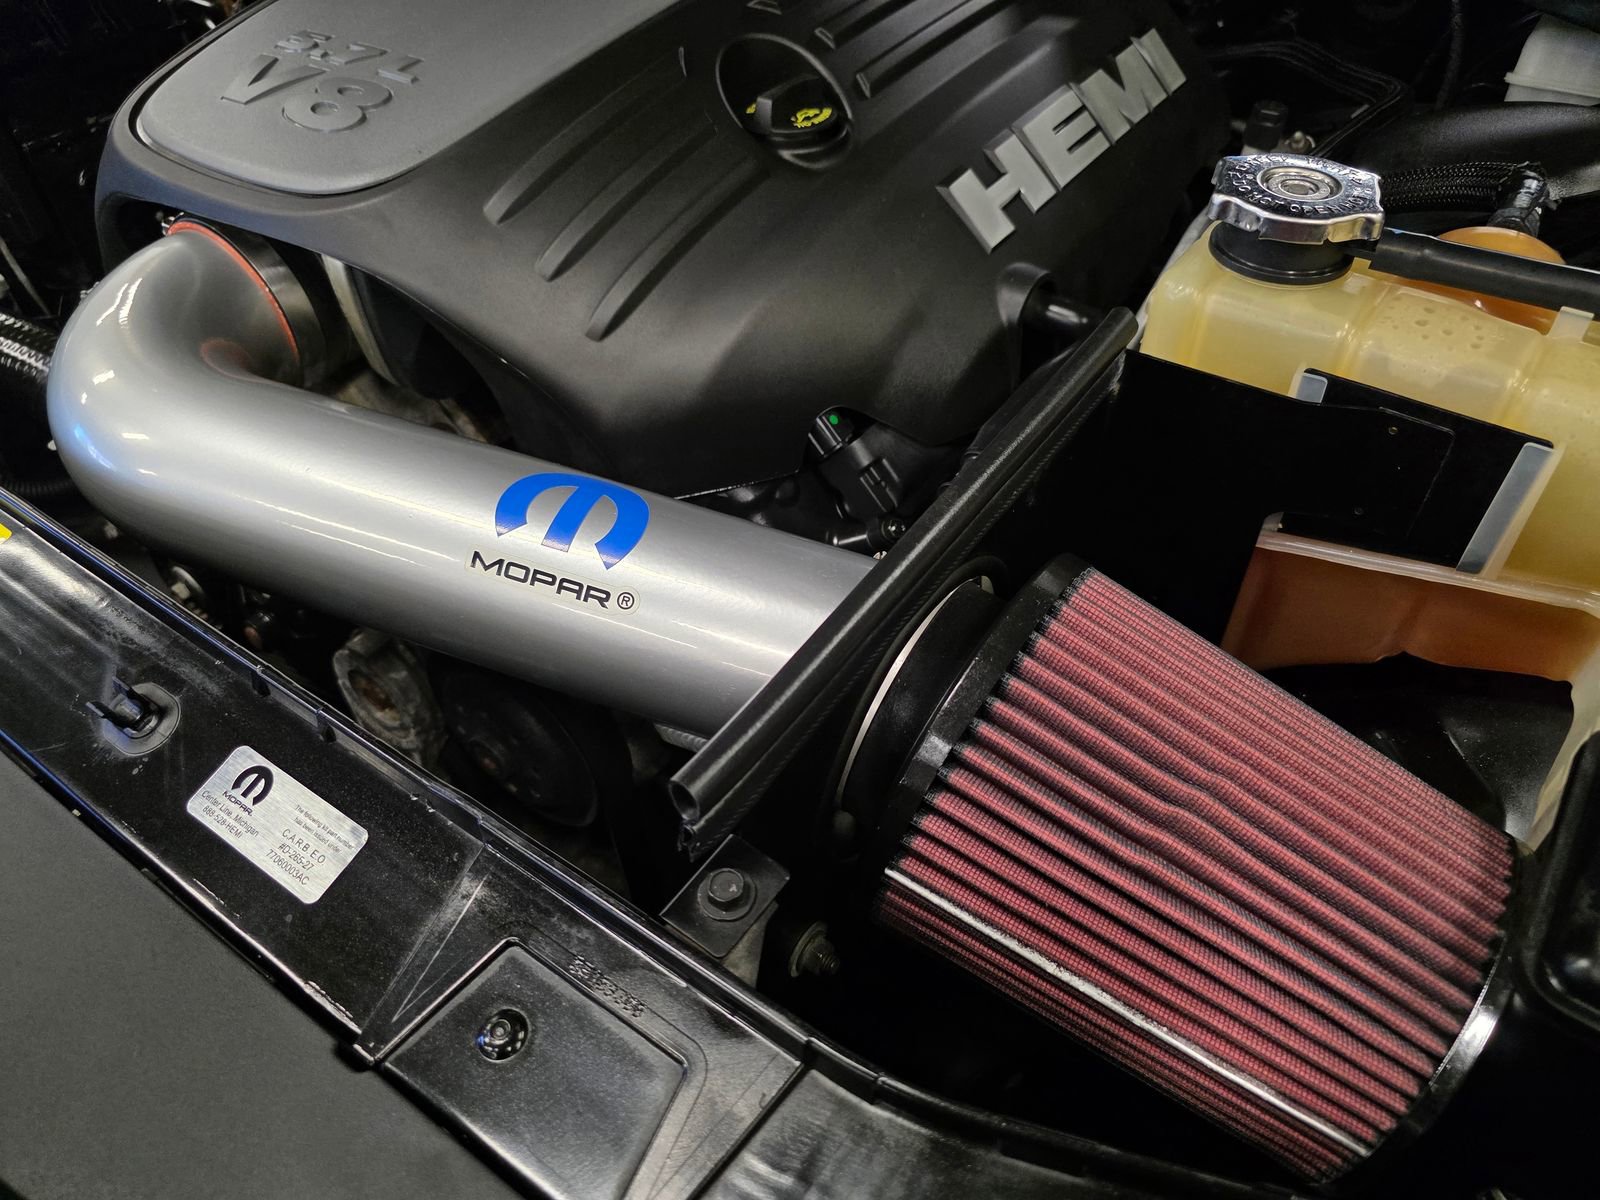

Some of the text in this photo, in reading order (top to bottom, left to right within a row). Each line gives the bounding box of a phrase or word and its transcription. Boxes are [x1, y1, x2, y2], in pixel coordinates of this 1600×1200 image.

[274, 29, 424, 85] 5.7L
[220, 53, 394, 133] V8
[935, 27, 1187, 255] HEMI
[469, 550, 611, 610] MOPAR
[201, 790, 222, 807] Center
[233, 815, 259, 837] Michigan
[202, 805, 243, 838] 888-528-HEMI
[266, 849, 309, 885] 77060003AC
[278, 842, 314, 871] #D-265-27
